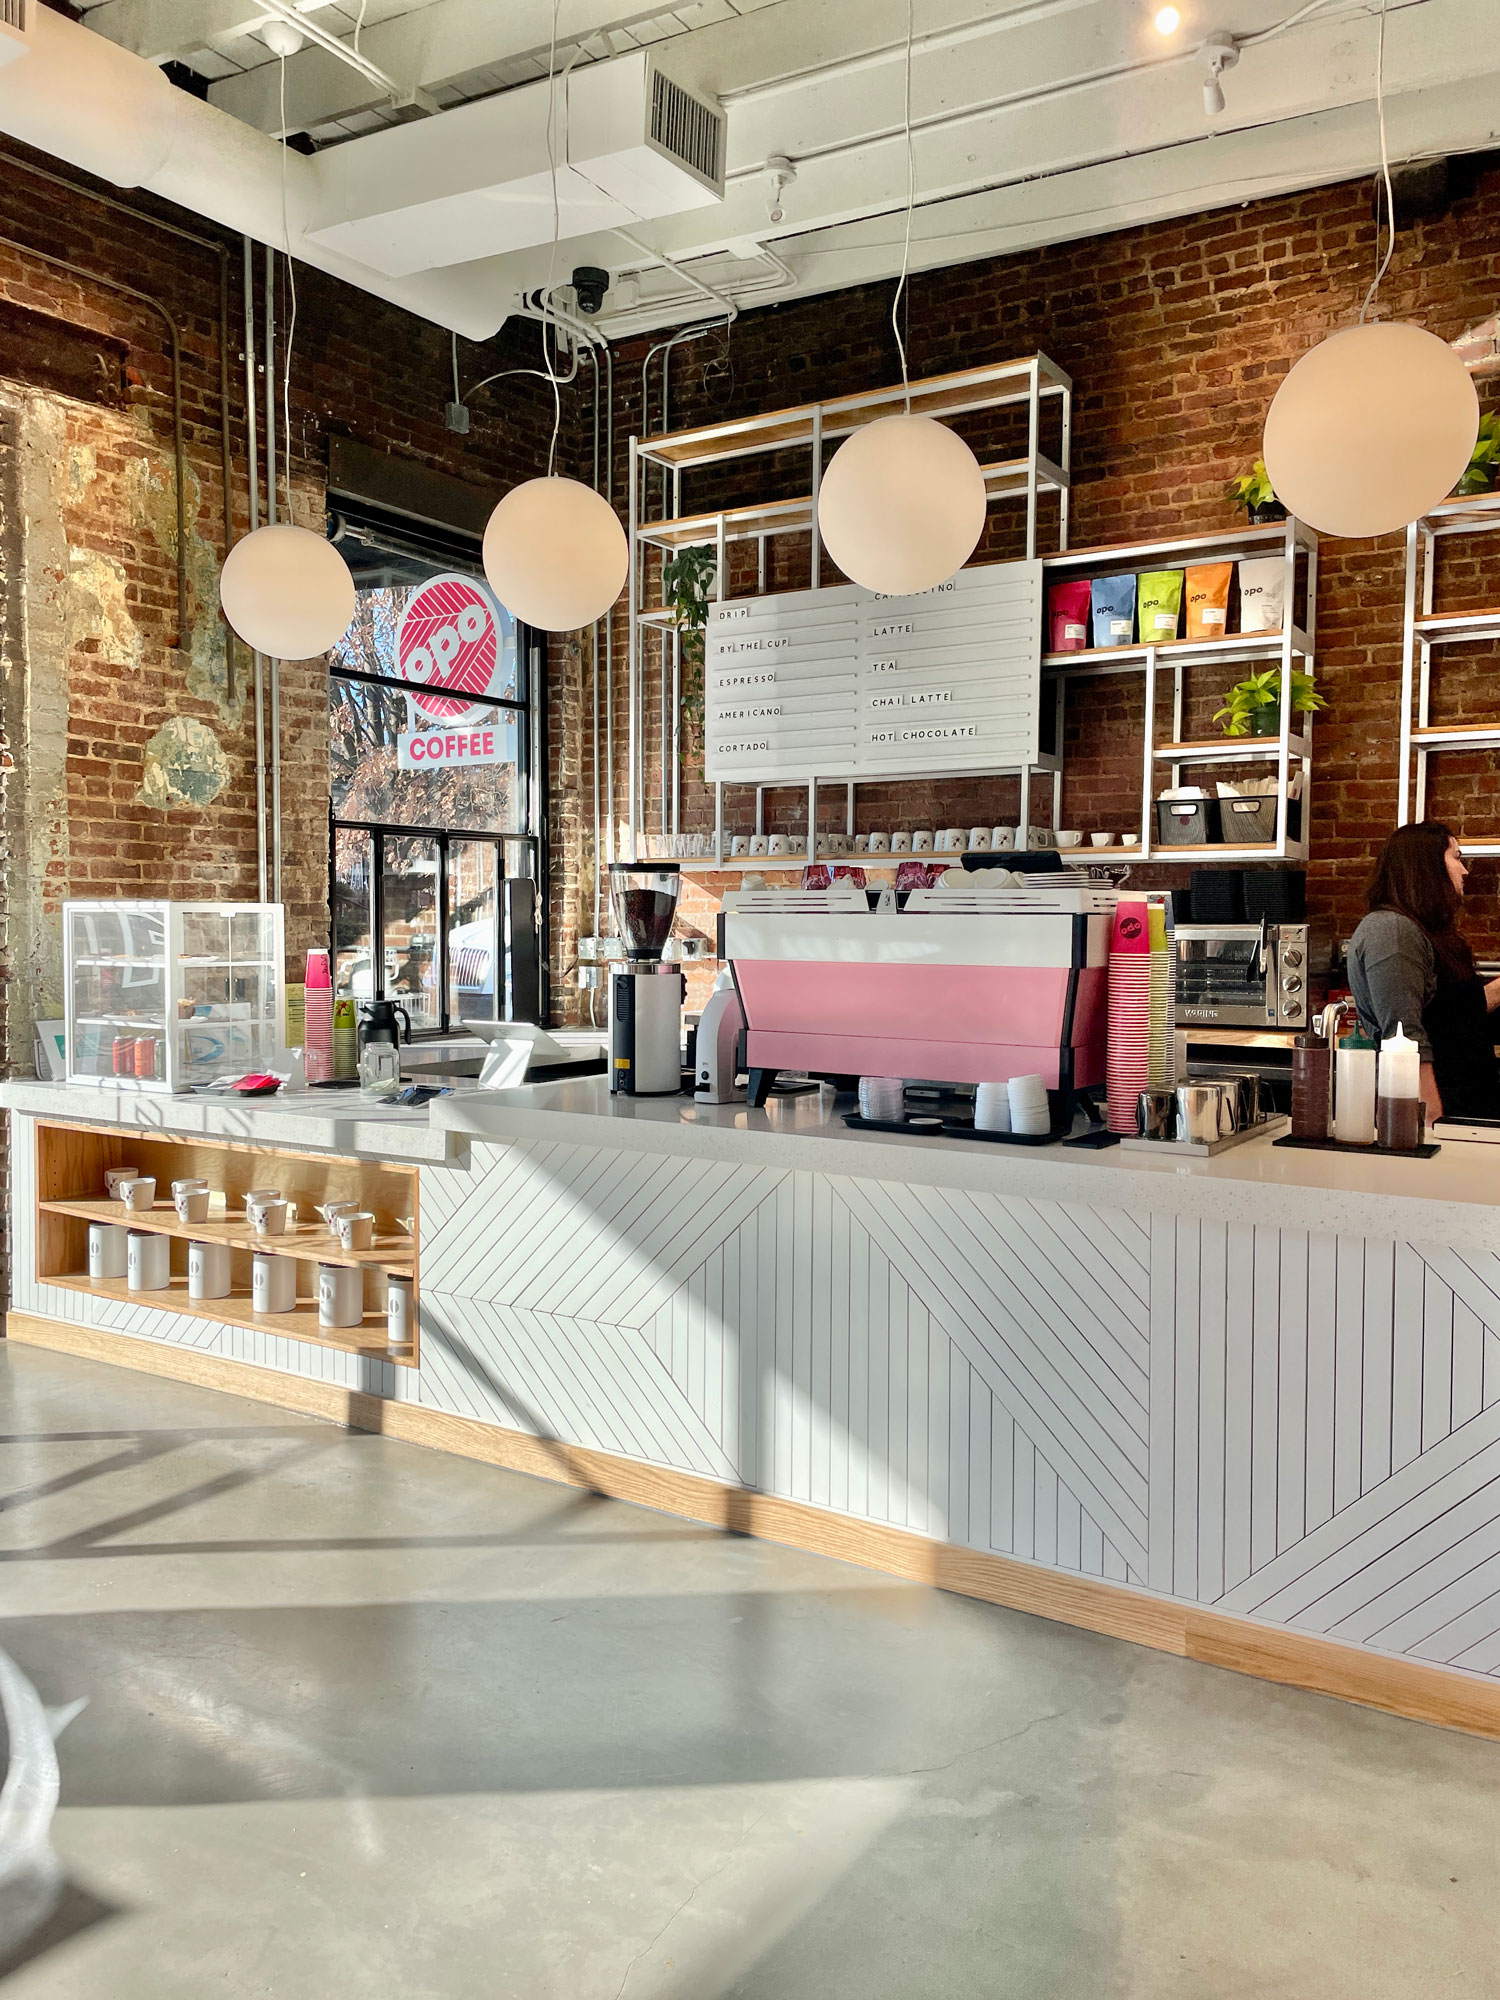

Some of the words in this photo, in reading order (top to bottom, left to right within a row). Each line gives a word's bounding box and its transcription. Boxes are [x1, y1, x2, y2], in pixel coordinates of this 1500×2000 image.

[1244, 587, 1263, 596] opo
[719, 610, 746, 619] DRIP
[1096, 605, 1114, 615] opo
[873, 624, 911, 636] LATTE
[405, 604, 487, 683] opo
[720, 645, 732, 653] BY
[740, 641, 758, 651] THE
[767, 639, 787, 648] CUP
[872, 662, 894, 671] TEA
[719, 674, 774, 687] ESPRESSO
[872, 698, 900, 707] CHAI
[911, 693, 949, 704] LATTE
[719, 708, 780, 719] AMERICANO
[871, 733, 893, 742] HOT
[902, 727, 974, 740] CHOCOLATE
[410, 731, 495, 761] COFFEE
[719, 742, 766, 752] CORTADO
